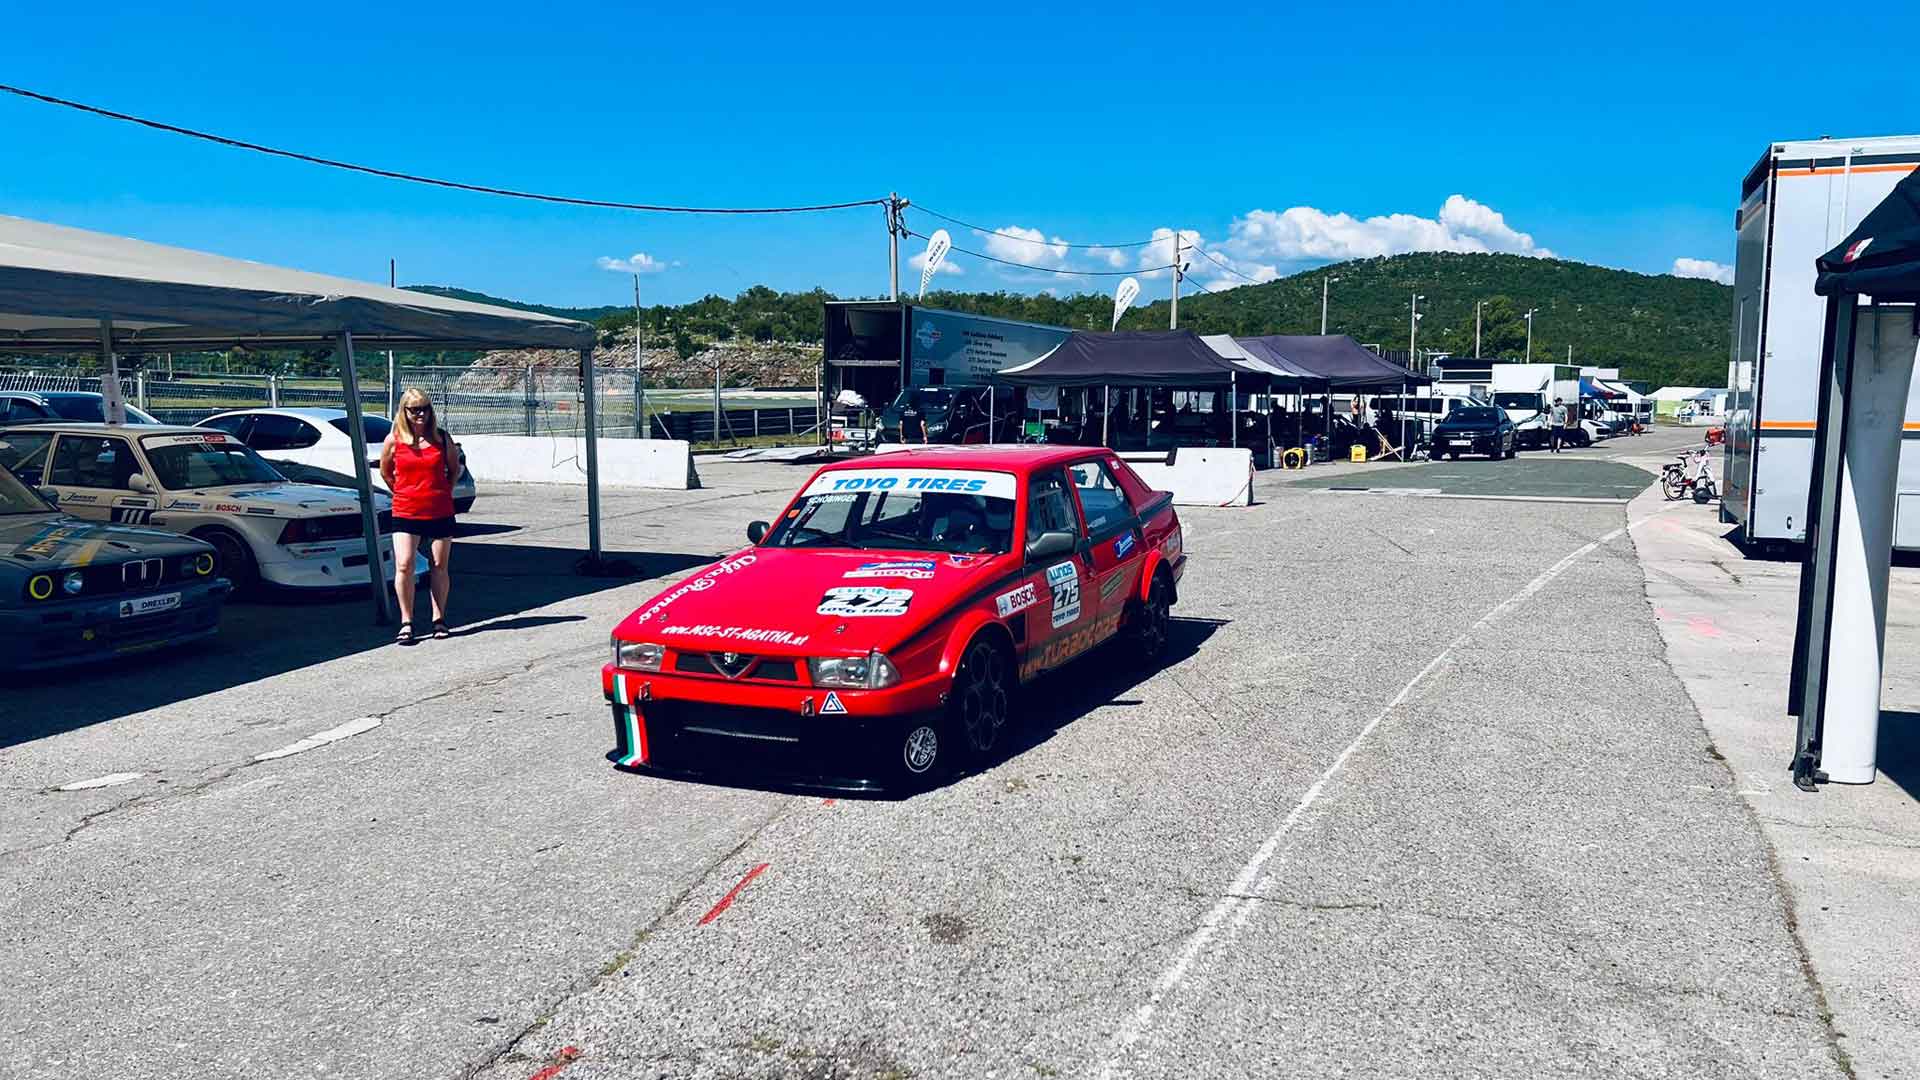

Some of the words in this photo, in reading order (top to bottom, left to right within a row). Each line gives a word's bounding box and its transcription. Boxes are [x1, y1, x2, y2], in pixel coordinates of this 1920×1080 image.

[906, 477, 987, 492] TIRES
[215, 504, 242, 512] BOSCH
[1009, 584, 1037, 609] BOSCH
[1053, 579, 1079, 609] 275
[141, 597, 176, 610] DREXLER
